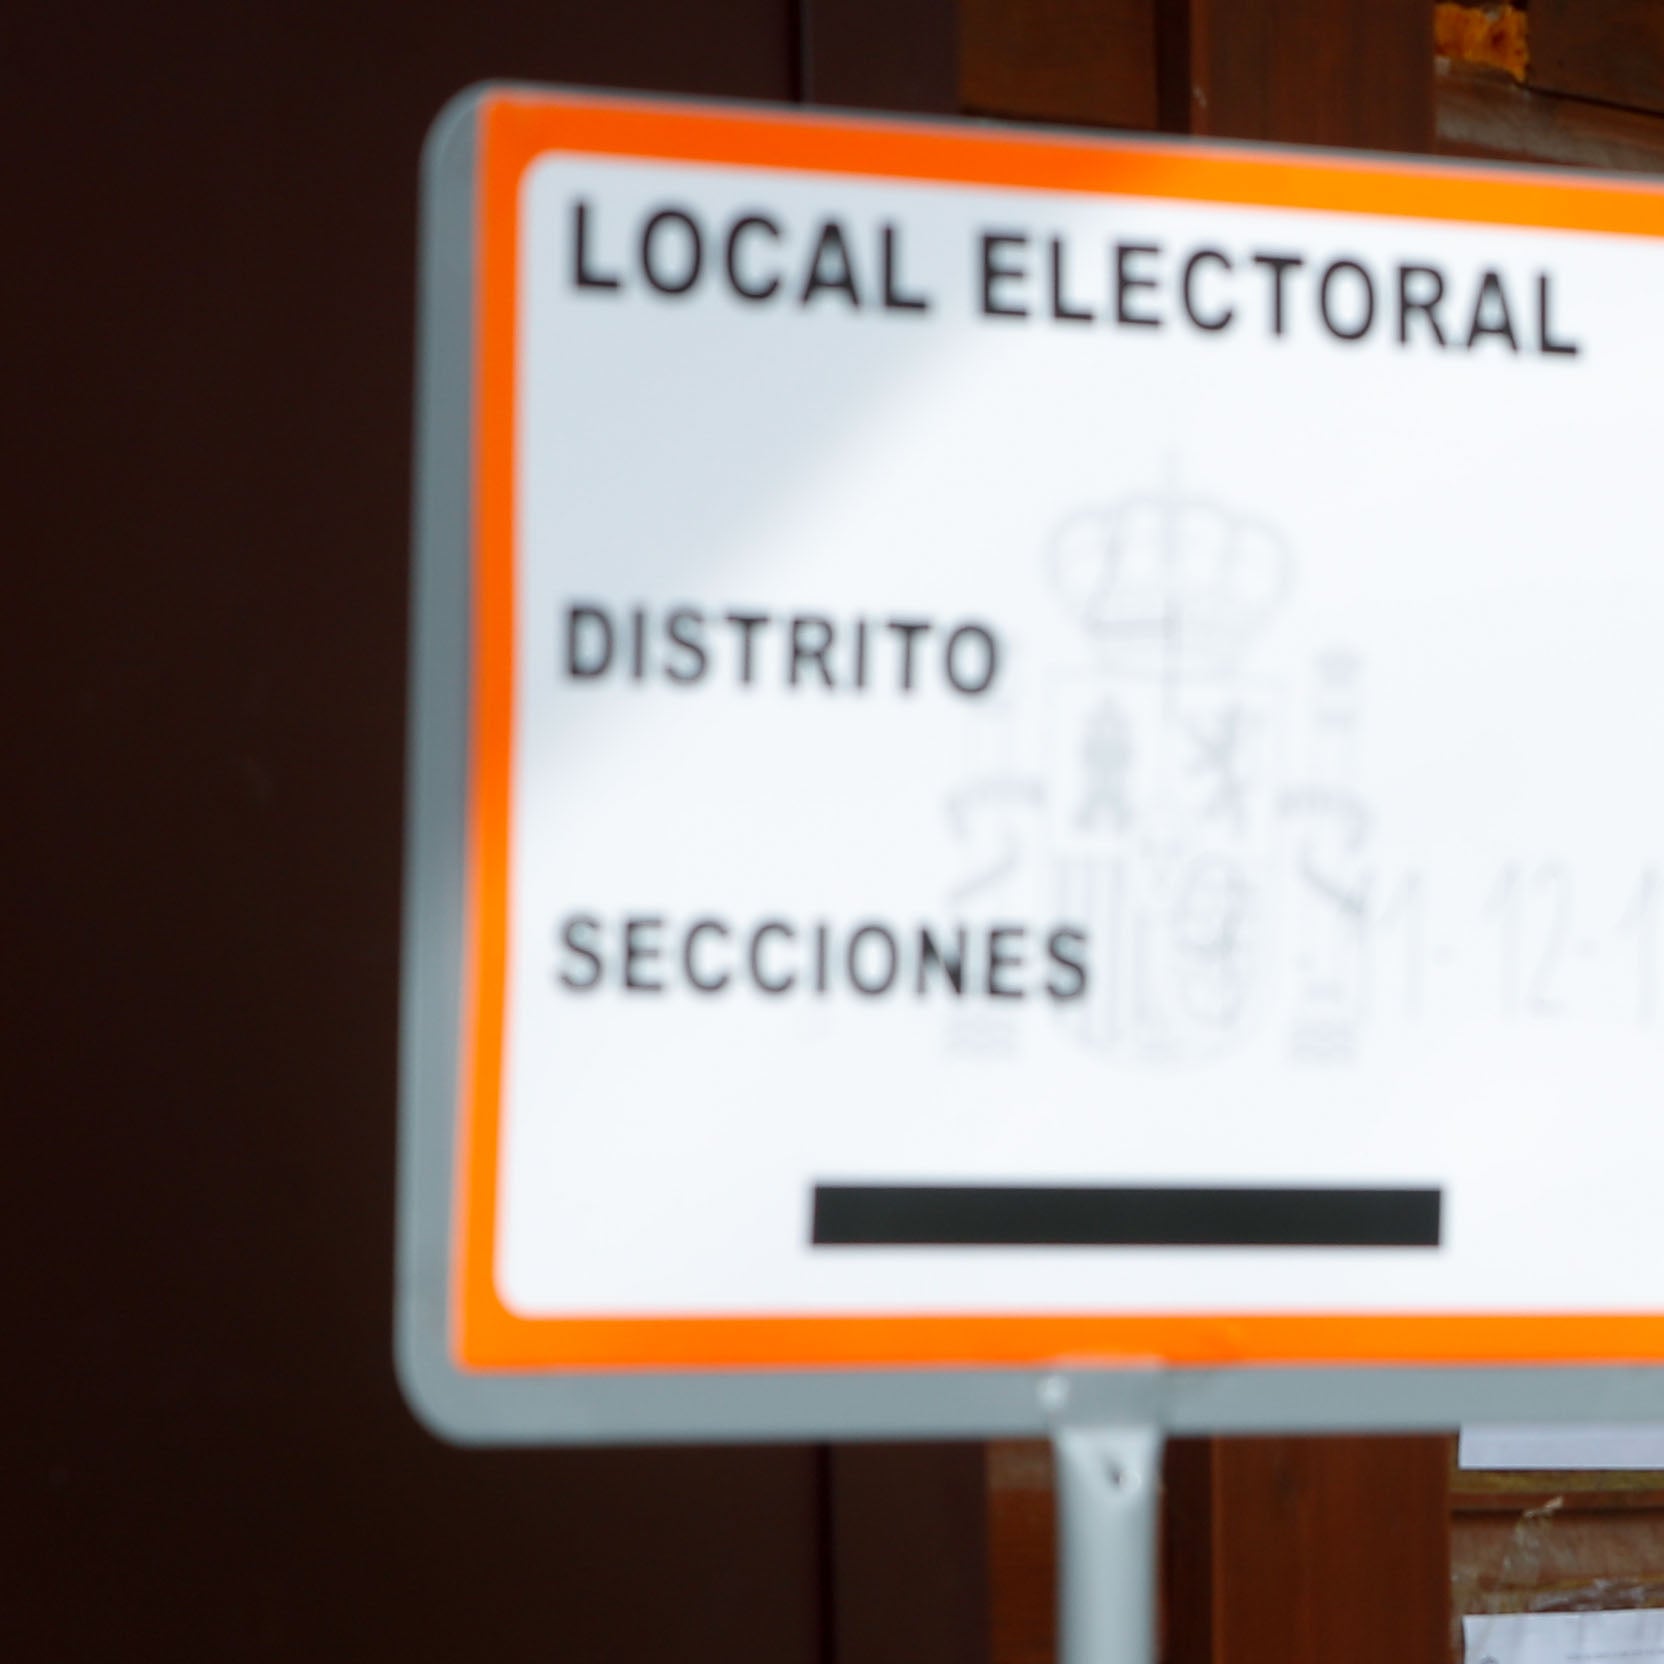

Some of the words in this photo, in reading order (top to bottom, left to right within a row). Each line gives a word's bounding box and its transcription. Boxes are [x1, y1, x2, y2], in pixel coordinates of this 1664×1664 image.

[569, 198, 934, 317] LOCAL
[977, 229, 1582, 360] ELECTORAL
[563, 603, 1000, 698] DISTRITO
[562, 918, 1090, 1000] SECCIONES
